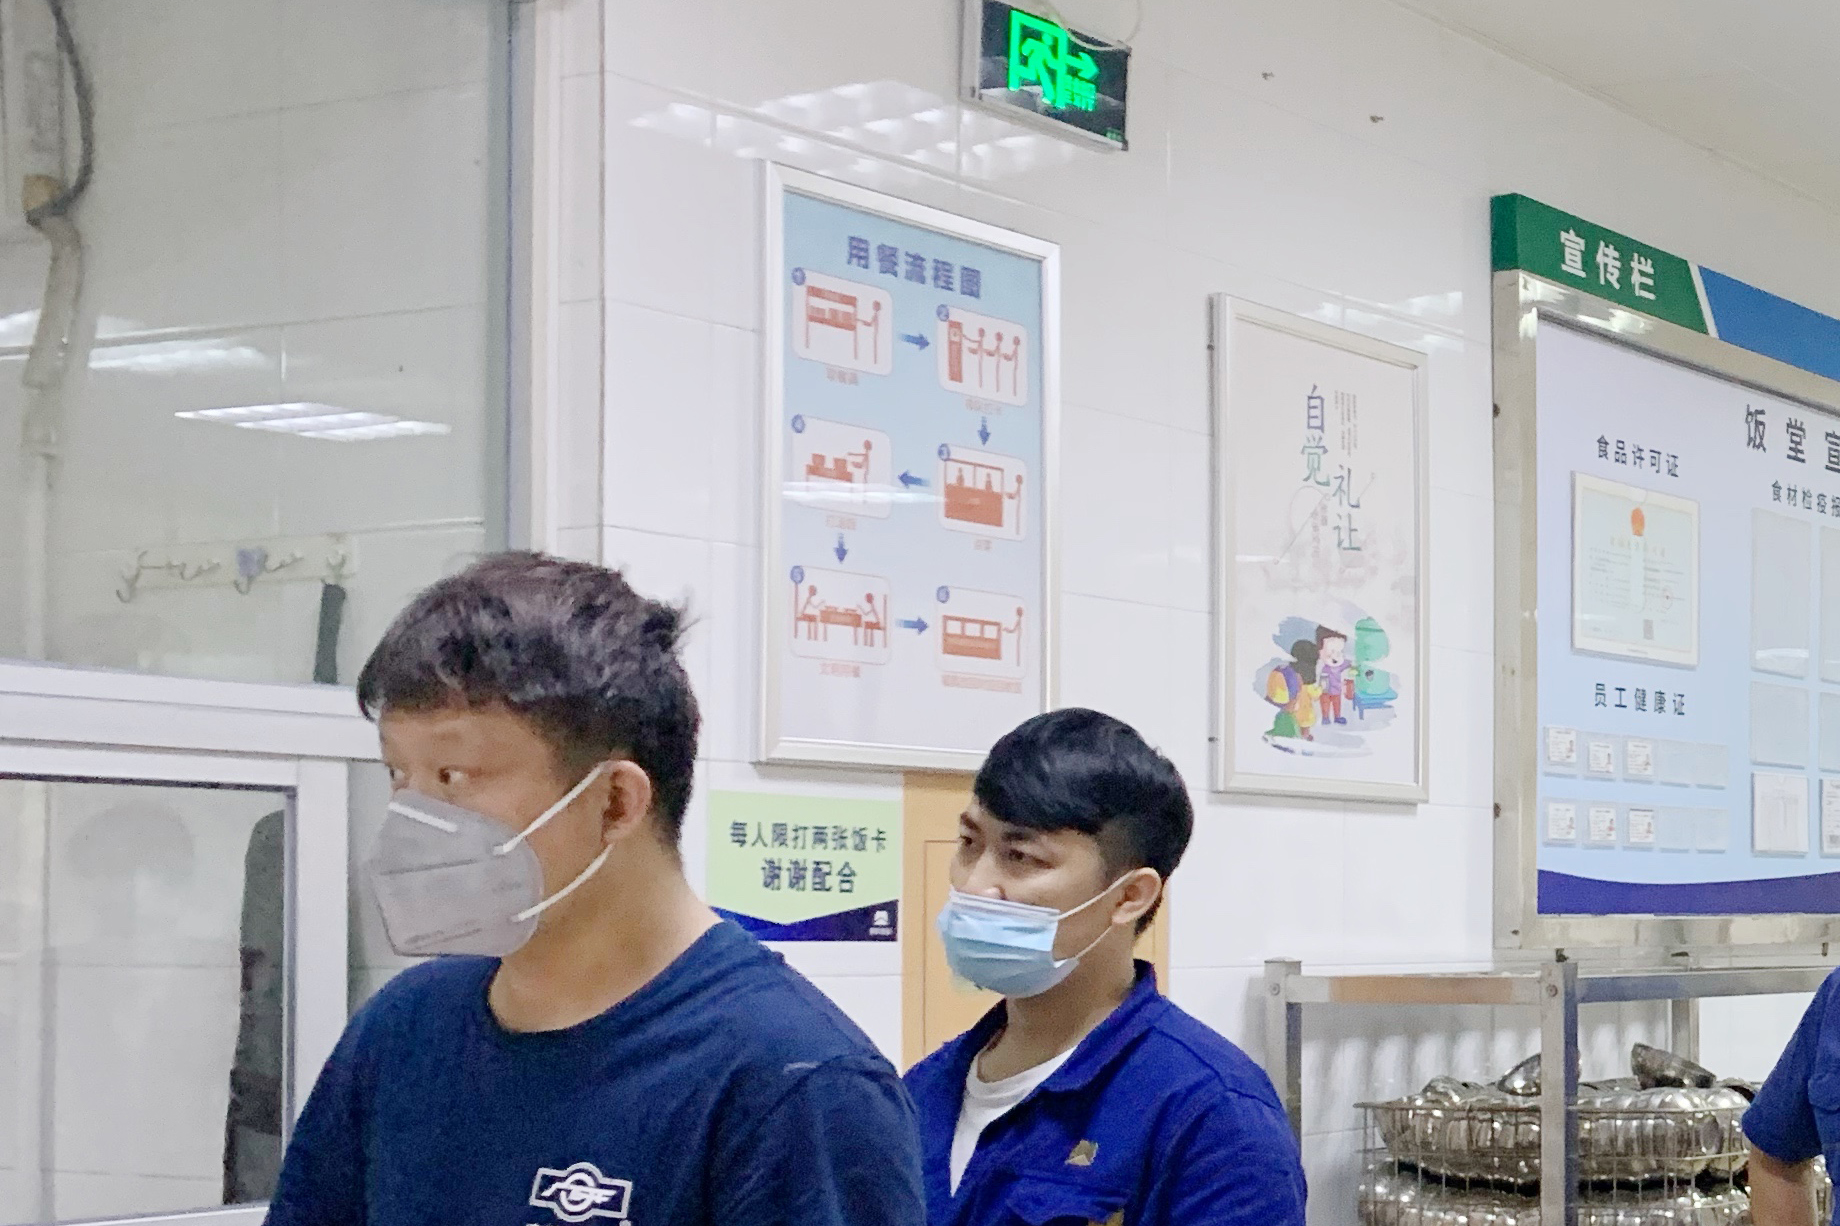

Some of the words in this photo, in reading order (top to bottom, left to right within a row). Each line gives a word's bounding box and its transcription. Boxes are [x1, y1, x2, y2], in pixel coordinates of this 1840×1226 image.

[847, 235, 981, 299] 用餐流程图
[1559, 226, 1656, 300] 宣传栏
[1301, 384, 1330, 486] 自觉
[1597, 434, 1679, 477] 食品许可证
[1332, 464, 1361, 551] 礼让
[1595, 683, 1685, 715] 员工健康证
[730, 819, 887, 852] 每人限打两张饭卡
[761, 857, 857, 893] 谢谢配合
